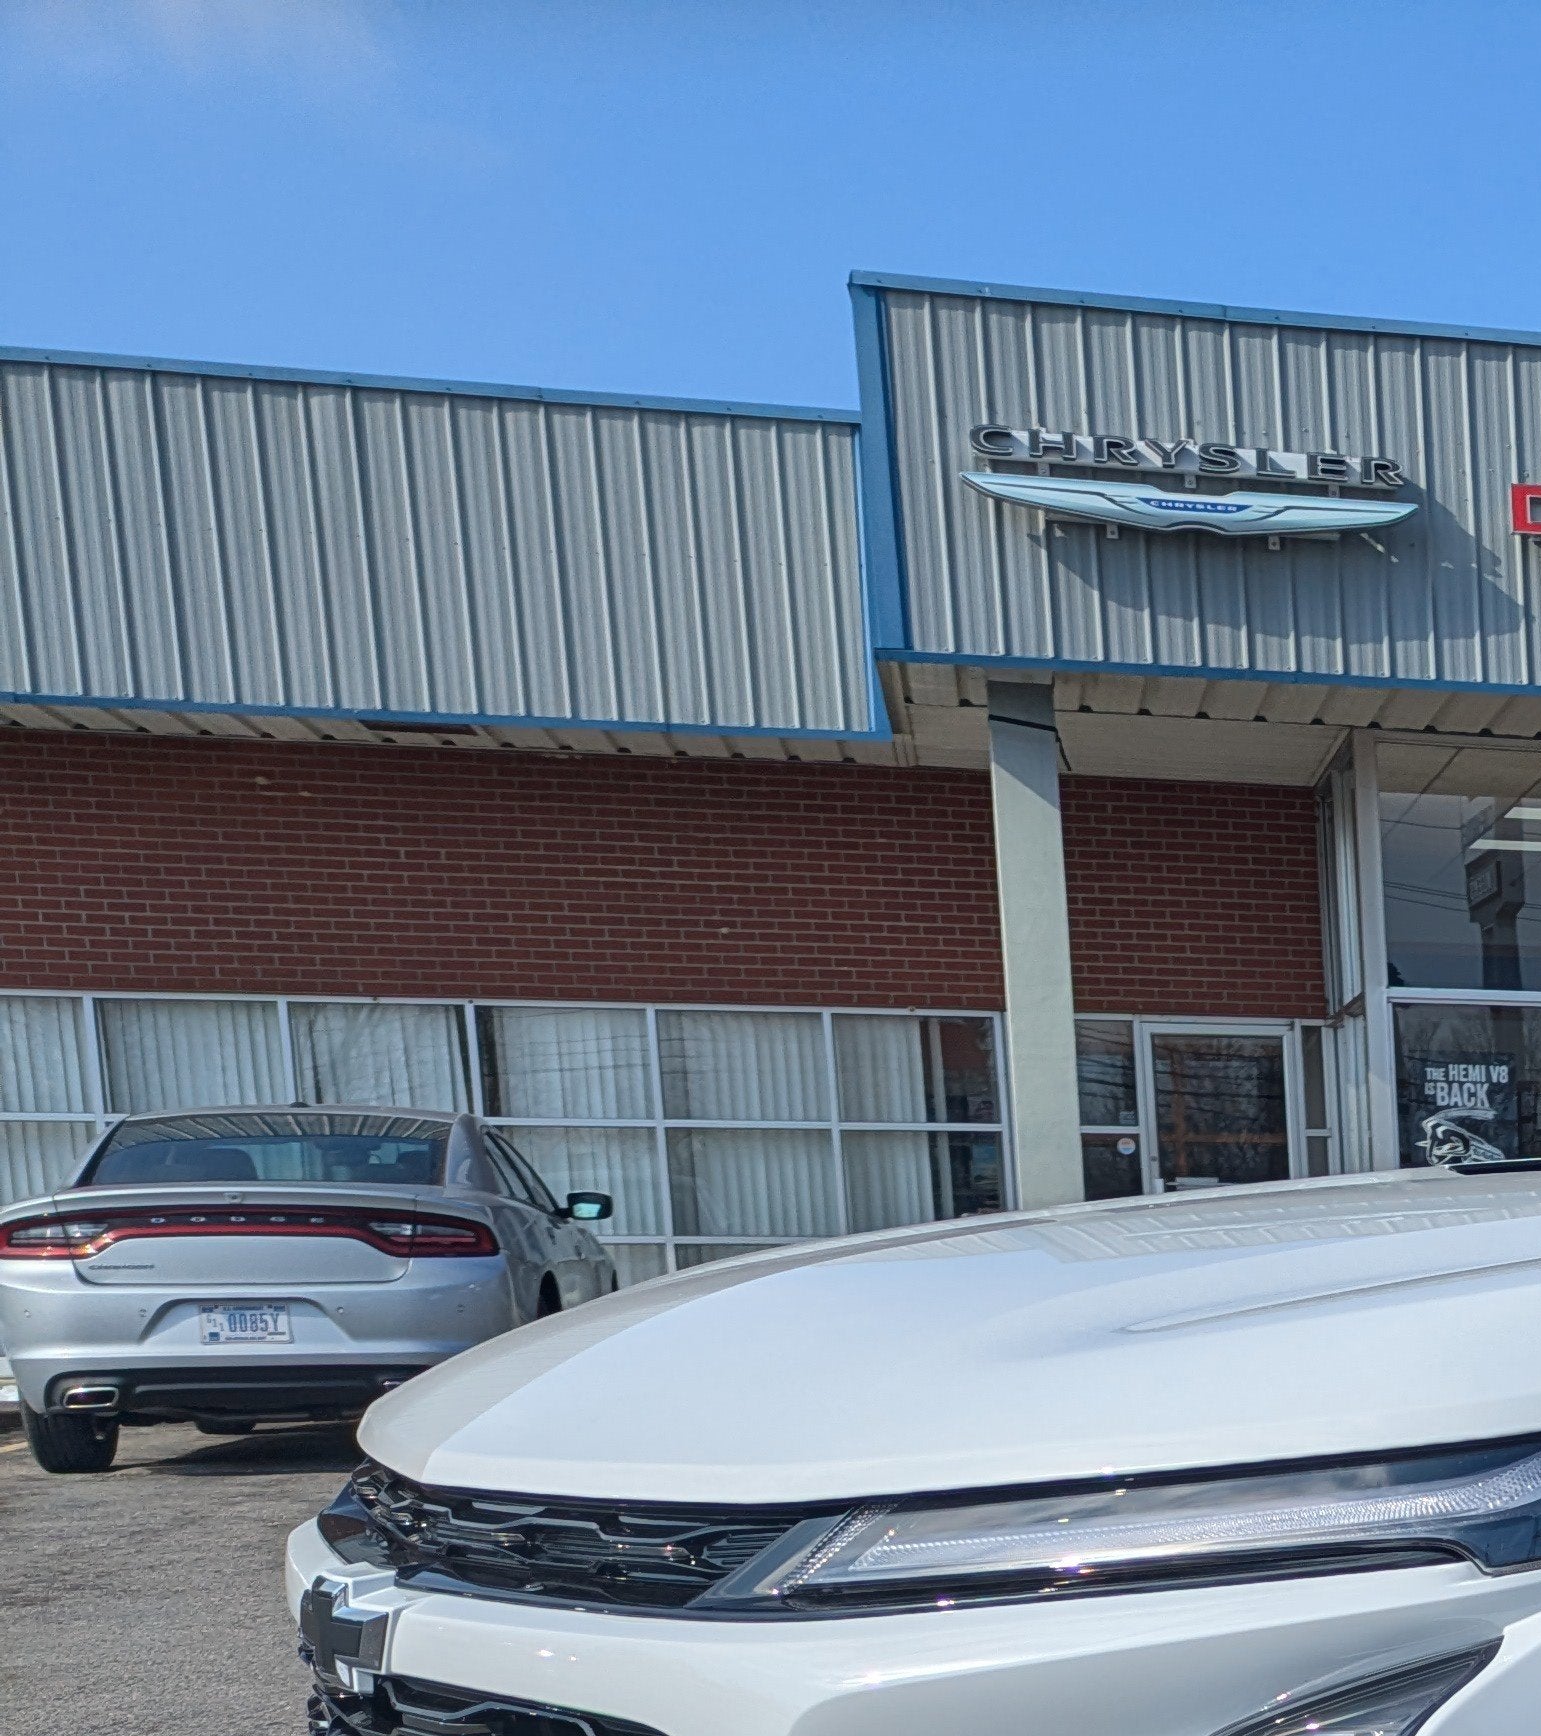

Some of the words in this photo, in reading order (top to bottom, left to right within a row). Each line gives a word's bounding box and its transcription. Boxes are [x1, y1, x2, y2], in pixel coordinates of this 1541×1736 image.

[969, 423, 1403, 486] CHRYSLER
[1150, 500, 1238, 512] CHRYSLER
[1424, 1067, 1446, 1080] THE
[1448, 1063, 1487, 1082] HEMI
[1489, 1065, 1509, 1083] V8
[1424, 1082, 1435, 1095] IS
[1436, 1082, 1489, 1110] BACK
